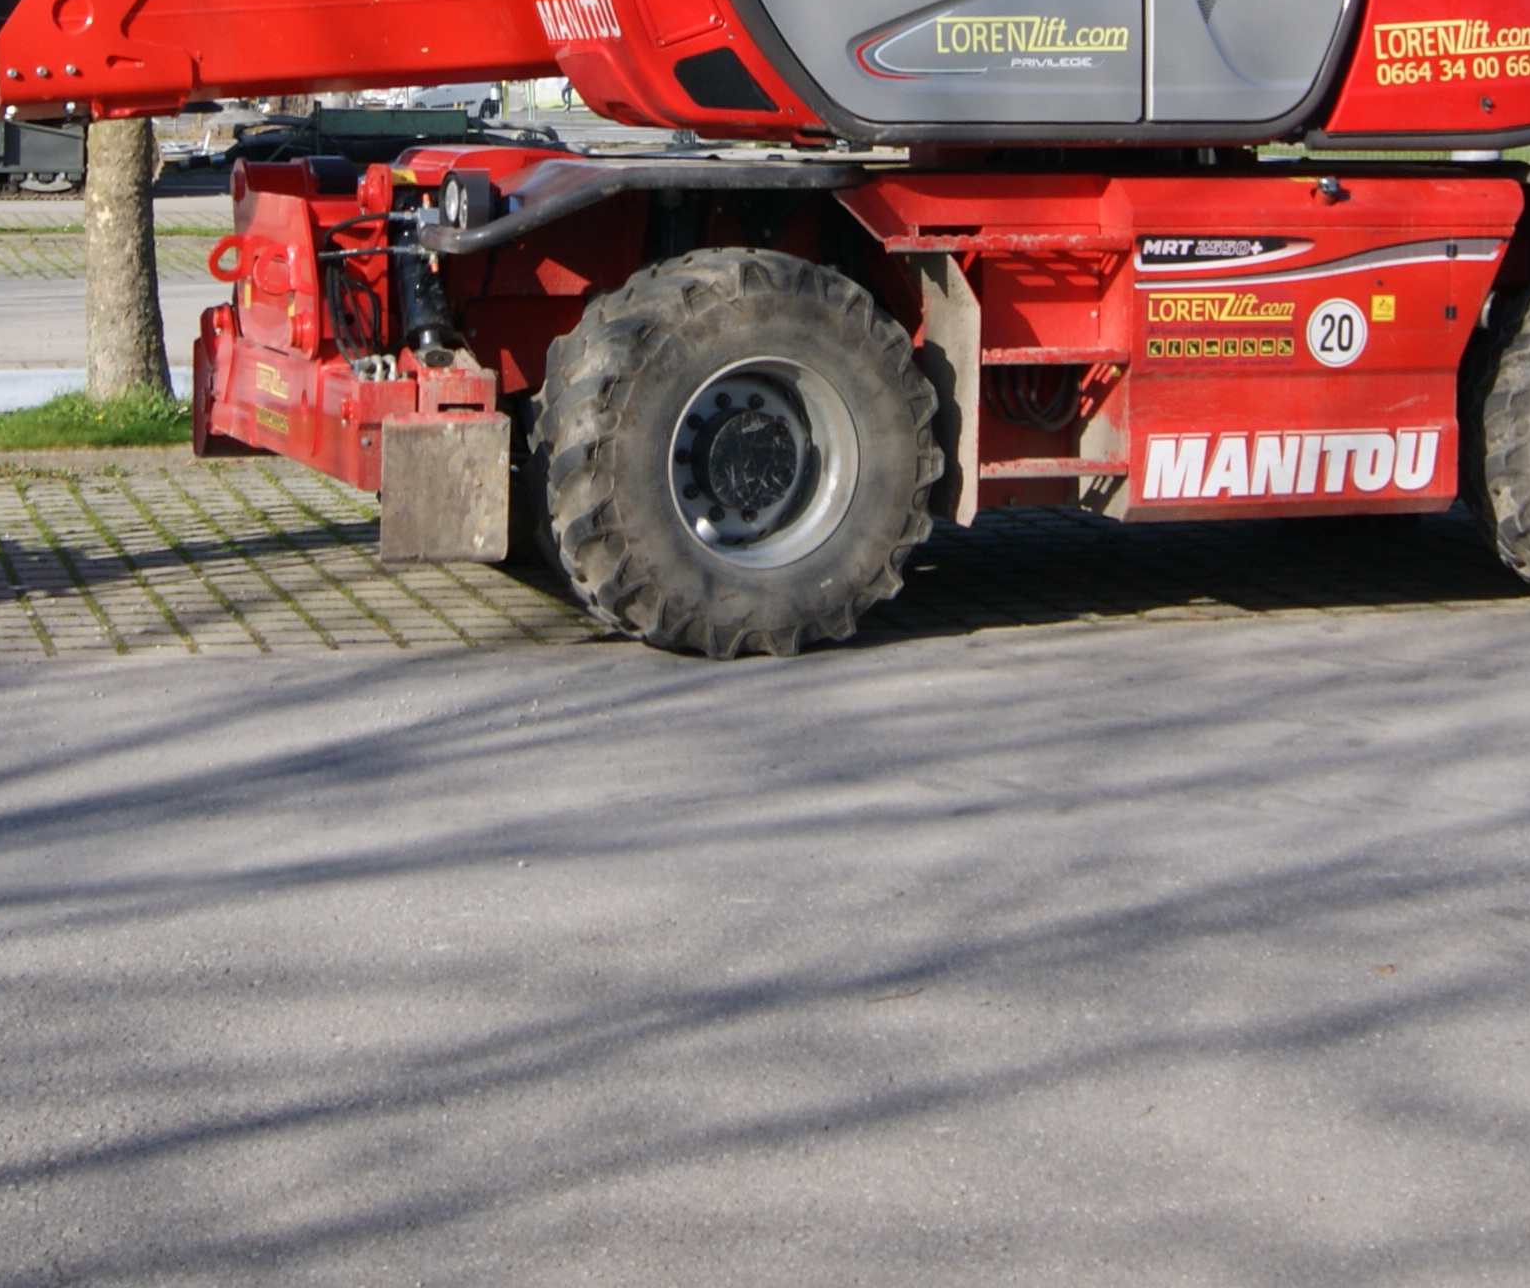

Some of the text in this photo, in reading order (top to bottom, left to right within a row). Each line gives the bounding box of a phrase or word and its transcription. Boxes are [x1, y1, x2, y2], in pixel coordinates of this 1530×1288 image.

[1010, 56, 1092, 68] PRIVILEGE
[1376, 61, 1432, 86] 0664
[1439, 59, 1466, 81] 34
[1472, 57, 1500, 79] 00
[1142, 239, 1195, 256] MRT
[1319, 313, 1355, 353] 20
[1142, 428, 1443, 500] MANITOU
